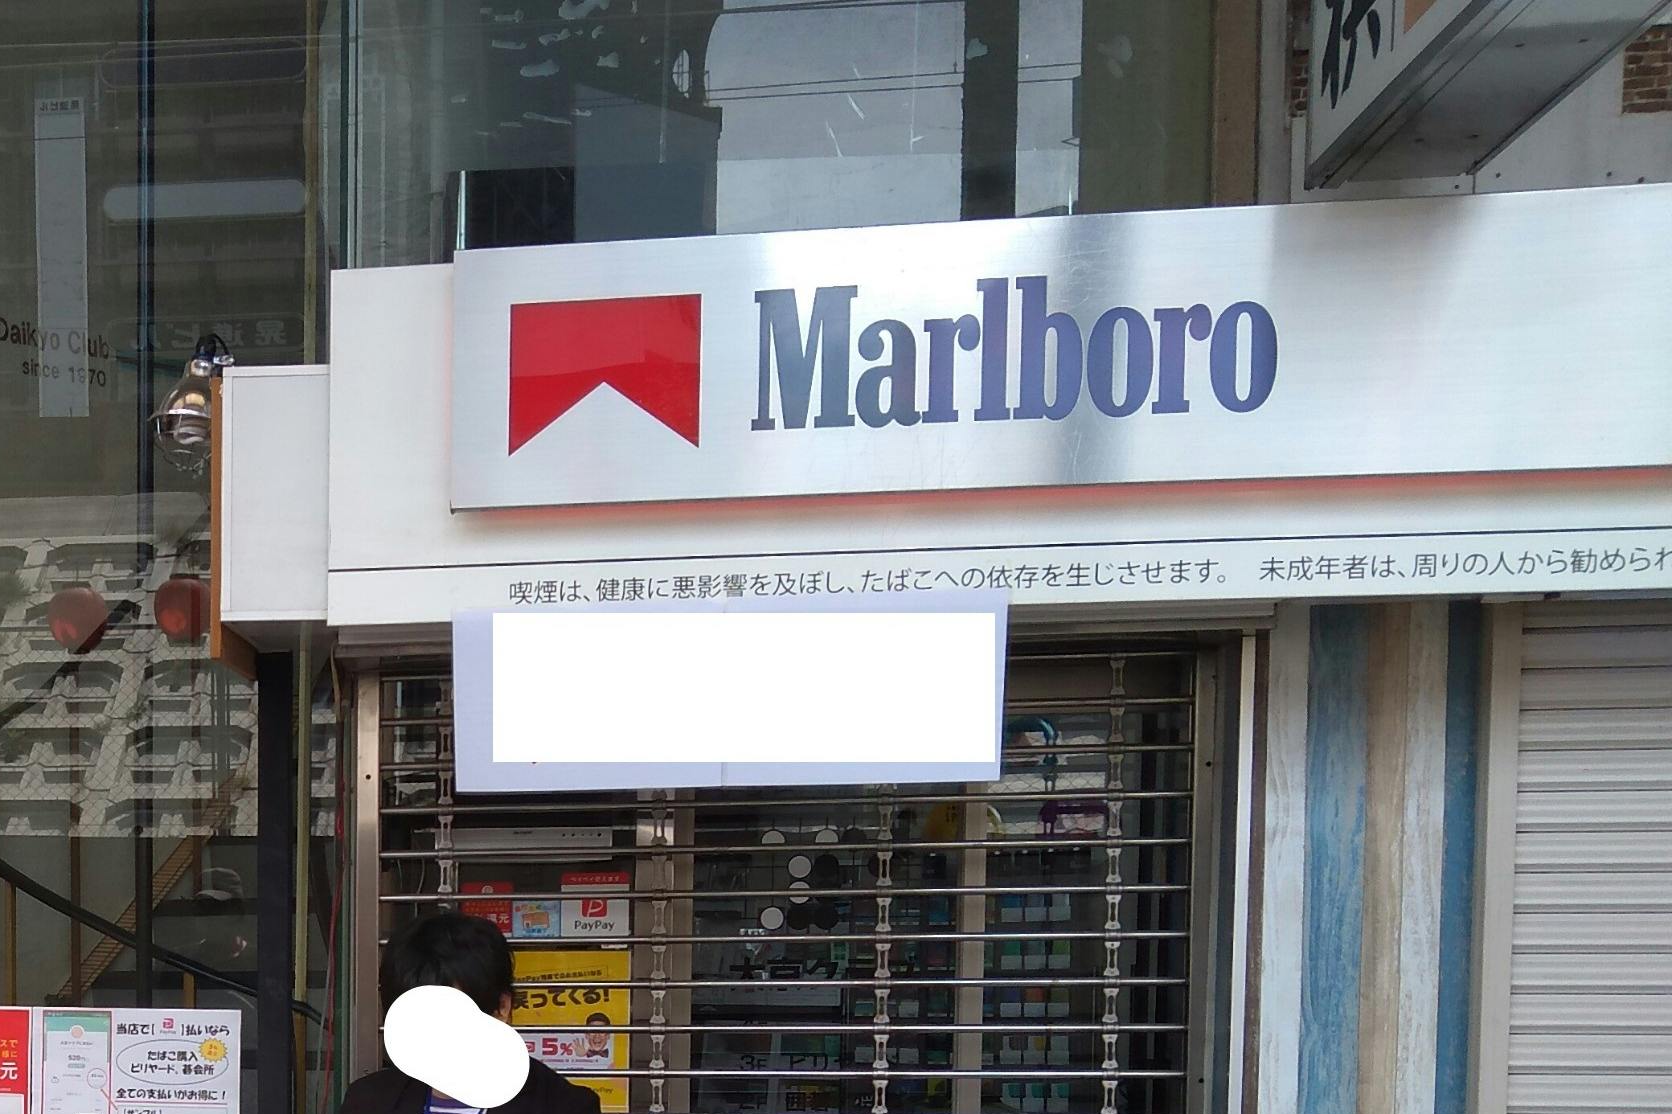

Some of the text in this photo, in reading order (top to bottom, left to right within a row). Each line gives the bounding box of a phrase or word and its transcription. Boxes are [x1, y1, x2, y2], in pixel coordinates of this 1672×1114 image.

[68, 330, 111, 360] Club
[751, 275, 1279, 432] Marlboro
[22, 358, 60, 380] since
[574, 920, 615, 931] PayPay
[147, 1050, 198, 1061] たばこ購入
[542, 1037, 574, 1056] 5%
